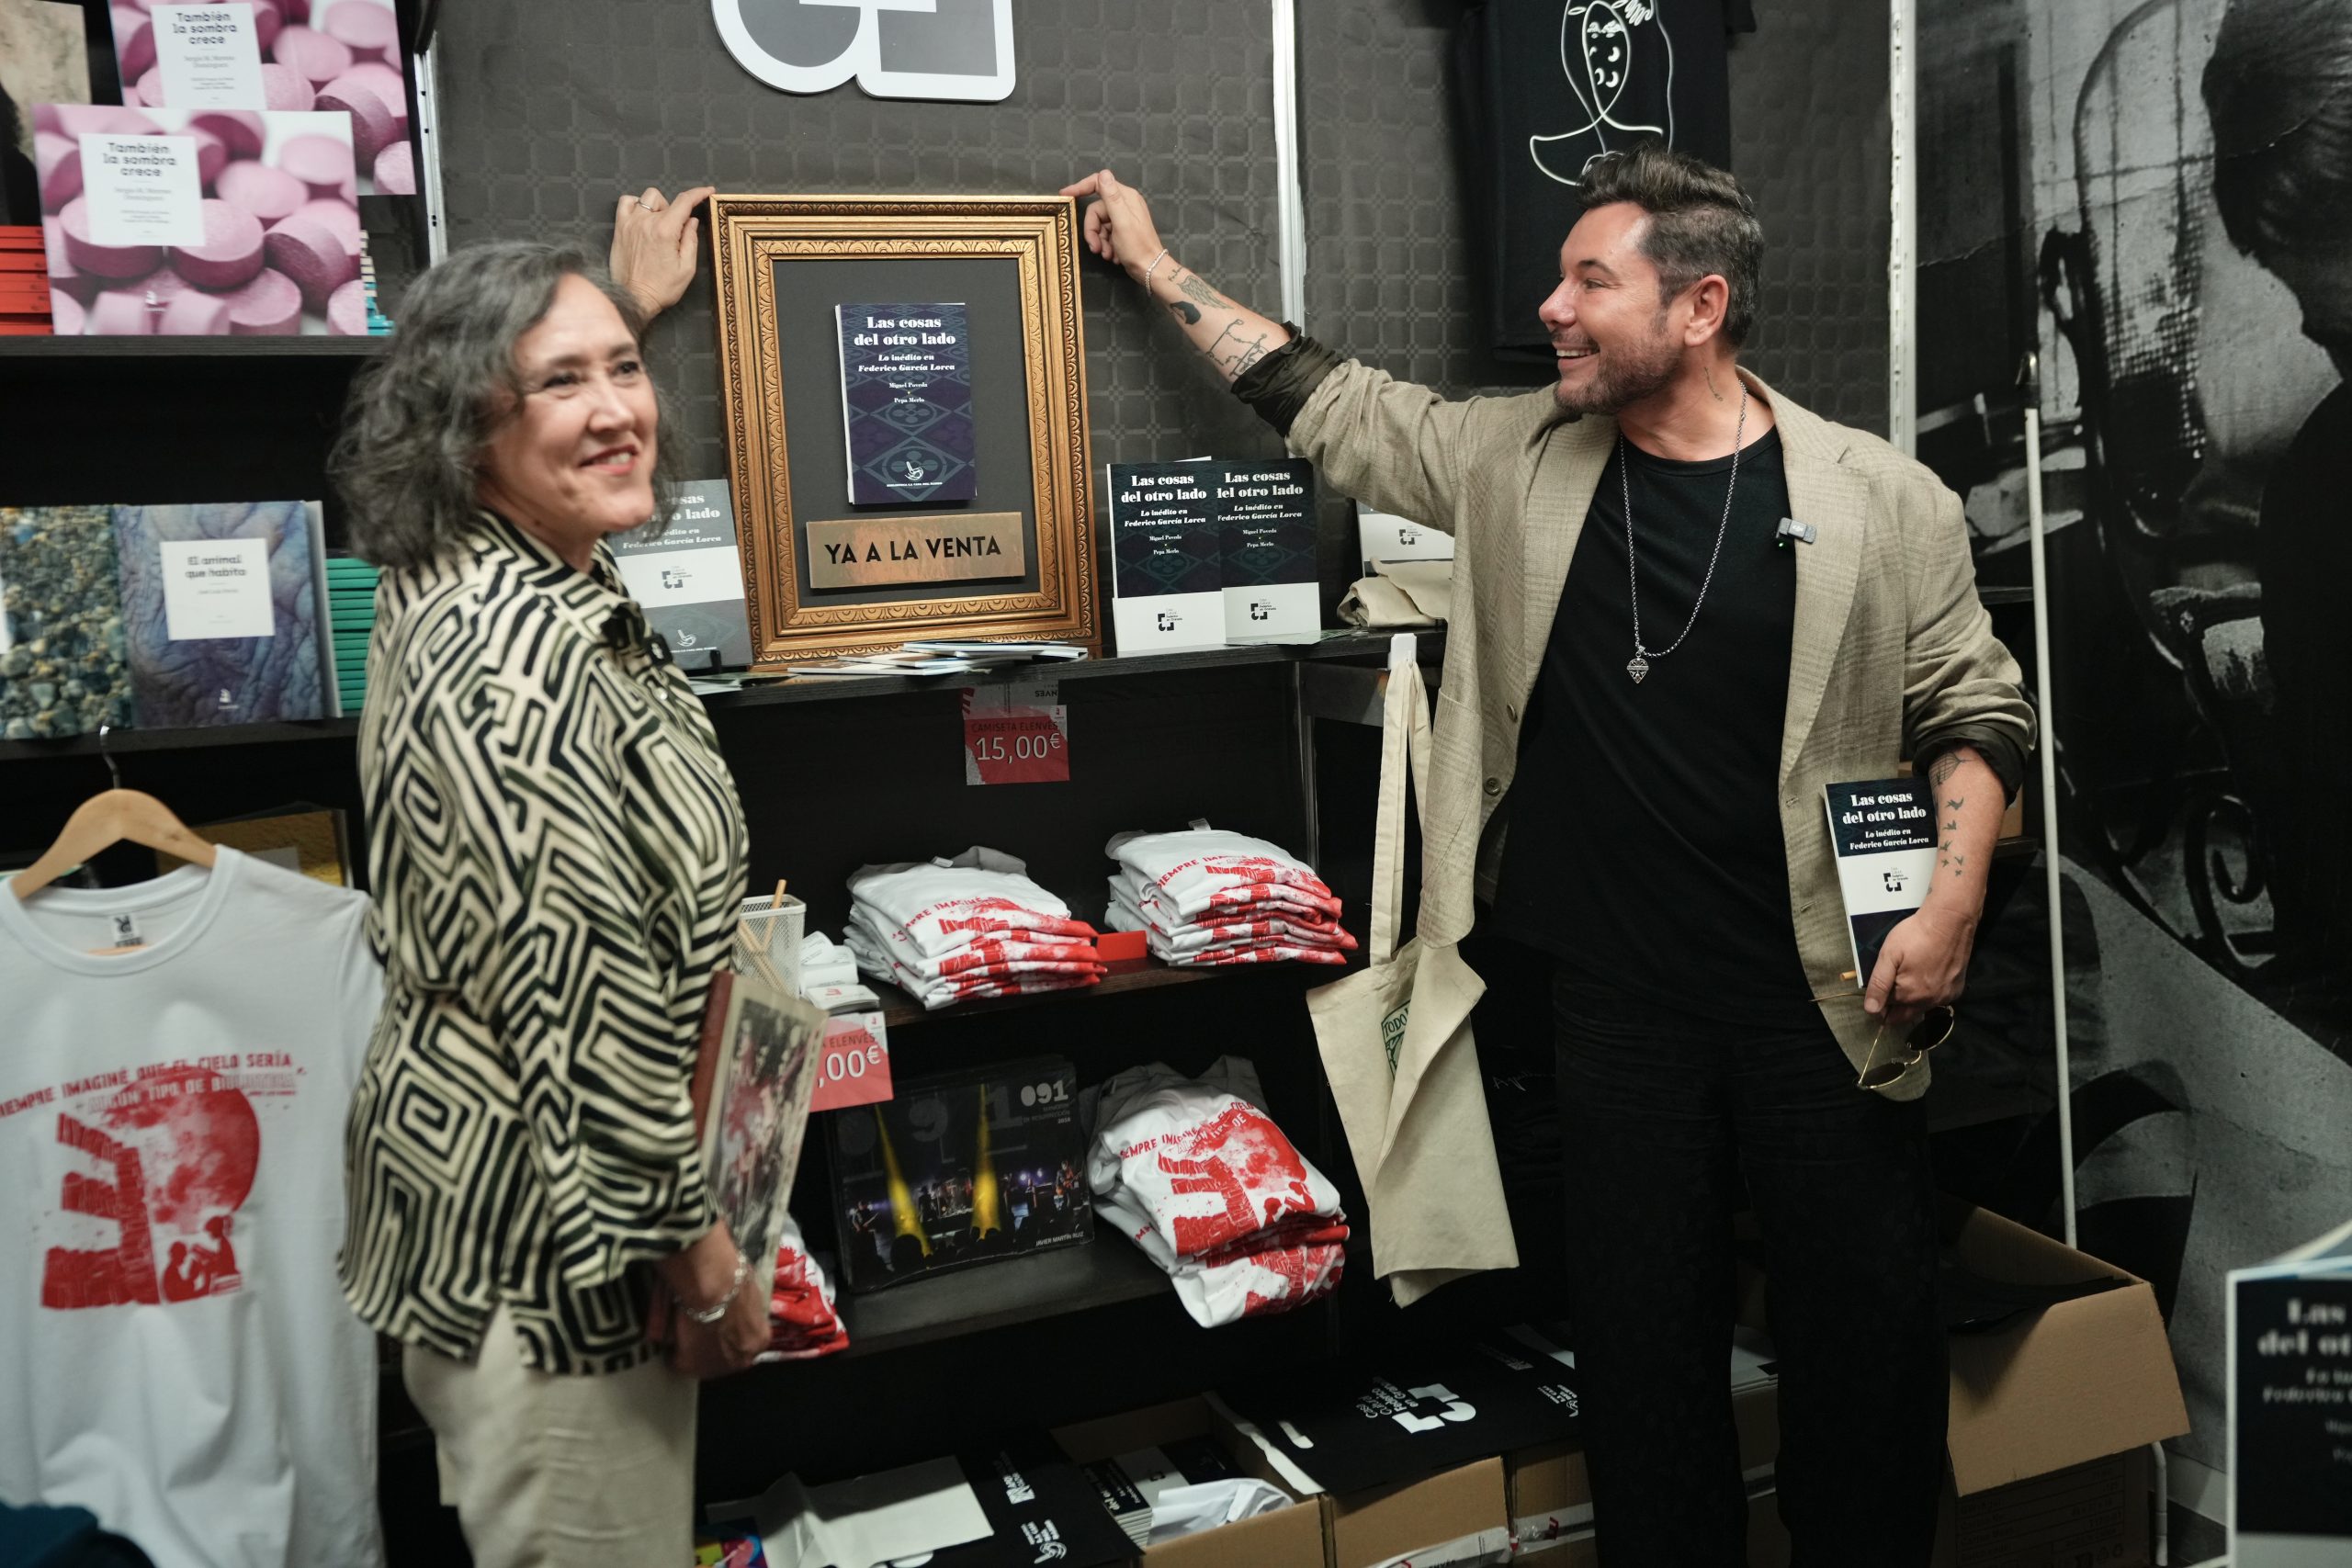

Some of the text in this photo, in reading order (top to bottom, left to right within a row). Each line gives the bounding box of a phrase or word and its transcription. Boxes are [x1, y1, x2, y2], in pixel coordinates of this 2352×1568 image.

[176, 11, 232, 22] También
[172, 23, 237, 34] la sombra
[188, 36, 225, 44] crece
[107, 141, 170, 154] También
[102, 152, 177, 165] la sombra
[120, 167, 162, 176] crece
[866, 317, 942, 329] Las cosas
[854, 333, 956, 346] del otro lado
[858, 364, 897, 372] Federico
[899, 363, 928, 371] García
[1131, 475, 1194, 487] Las cosas
[1224, 471, 1290, 483] Las cosas
[1121, 489, 1207, 503] del otro lado
[1238, 487, 1268, 497] otro
[1272, 484, 1304, 495] lado
[685, 507, 720, 520] lado
[1217, 513, 1250, 522] Federico
[663, 536, 694, 546] García
[824, 535, 1001, 564] YA A LA VENTA
[187, 554, 242, 565] El animal
[185, 568, 246, 579] que habita
[972, 721, 1017, 733] CAMISETA
[976, 732, 1060, 764] 15,00€
[1850, 793, 1913, 807] Las cosas
[1842, 807, 1927, 825] del otro lado
[1865, 830, 1874, 839] Lo
[1875, 829, 1901, 838] inédito
[1849, 837, 1928, 850] Federico García Lorca
[1384, 1014, 1408, 1038] TODO
[186, 1078, 206, 1094] DE
[1020, 1079, 1069, 1107] 091
[1232, 1112, 1247, 1127] DE
[2287, 1297, 2346, 1325] Las
[2257, 1328, 2310, 1357] del
